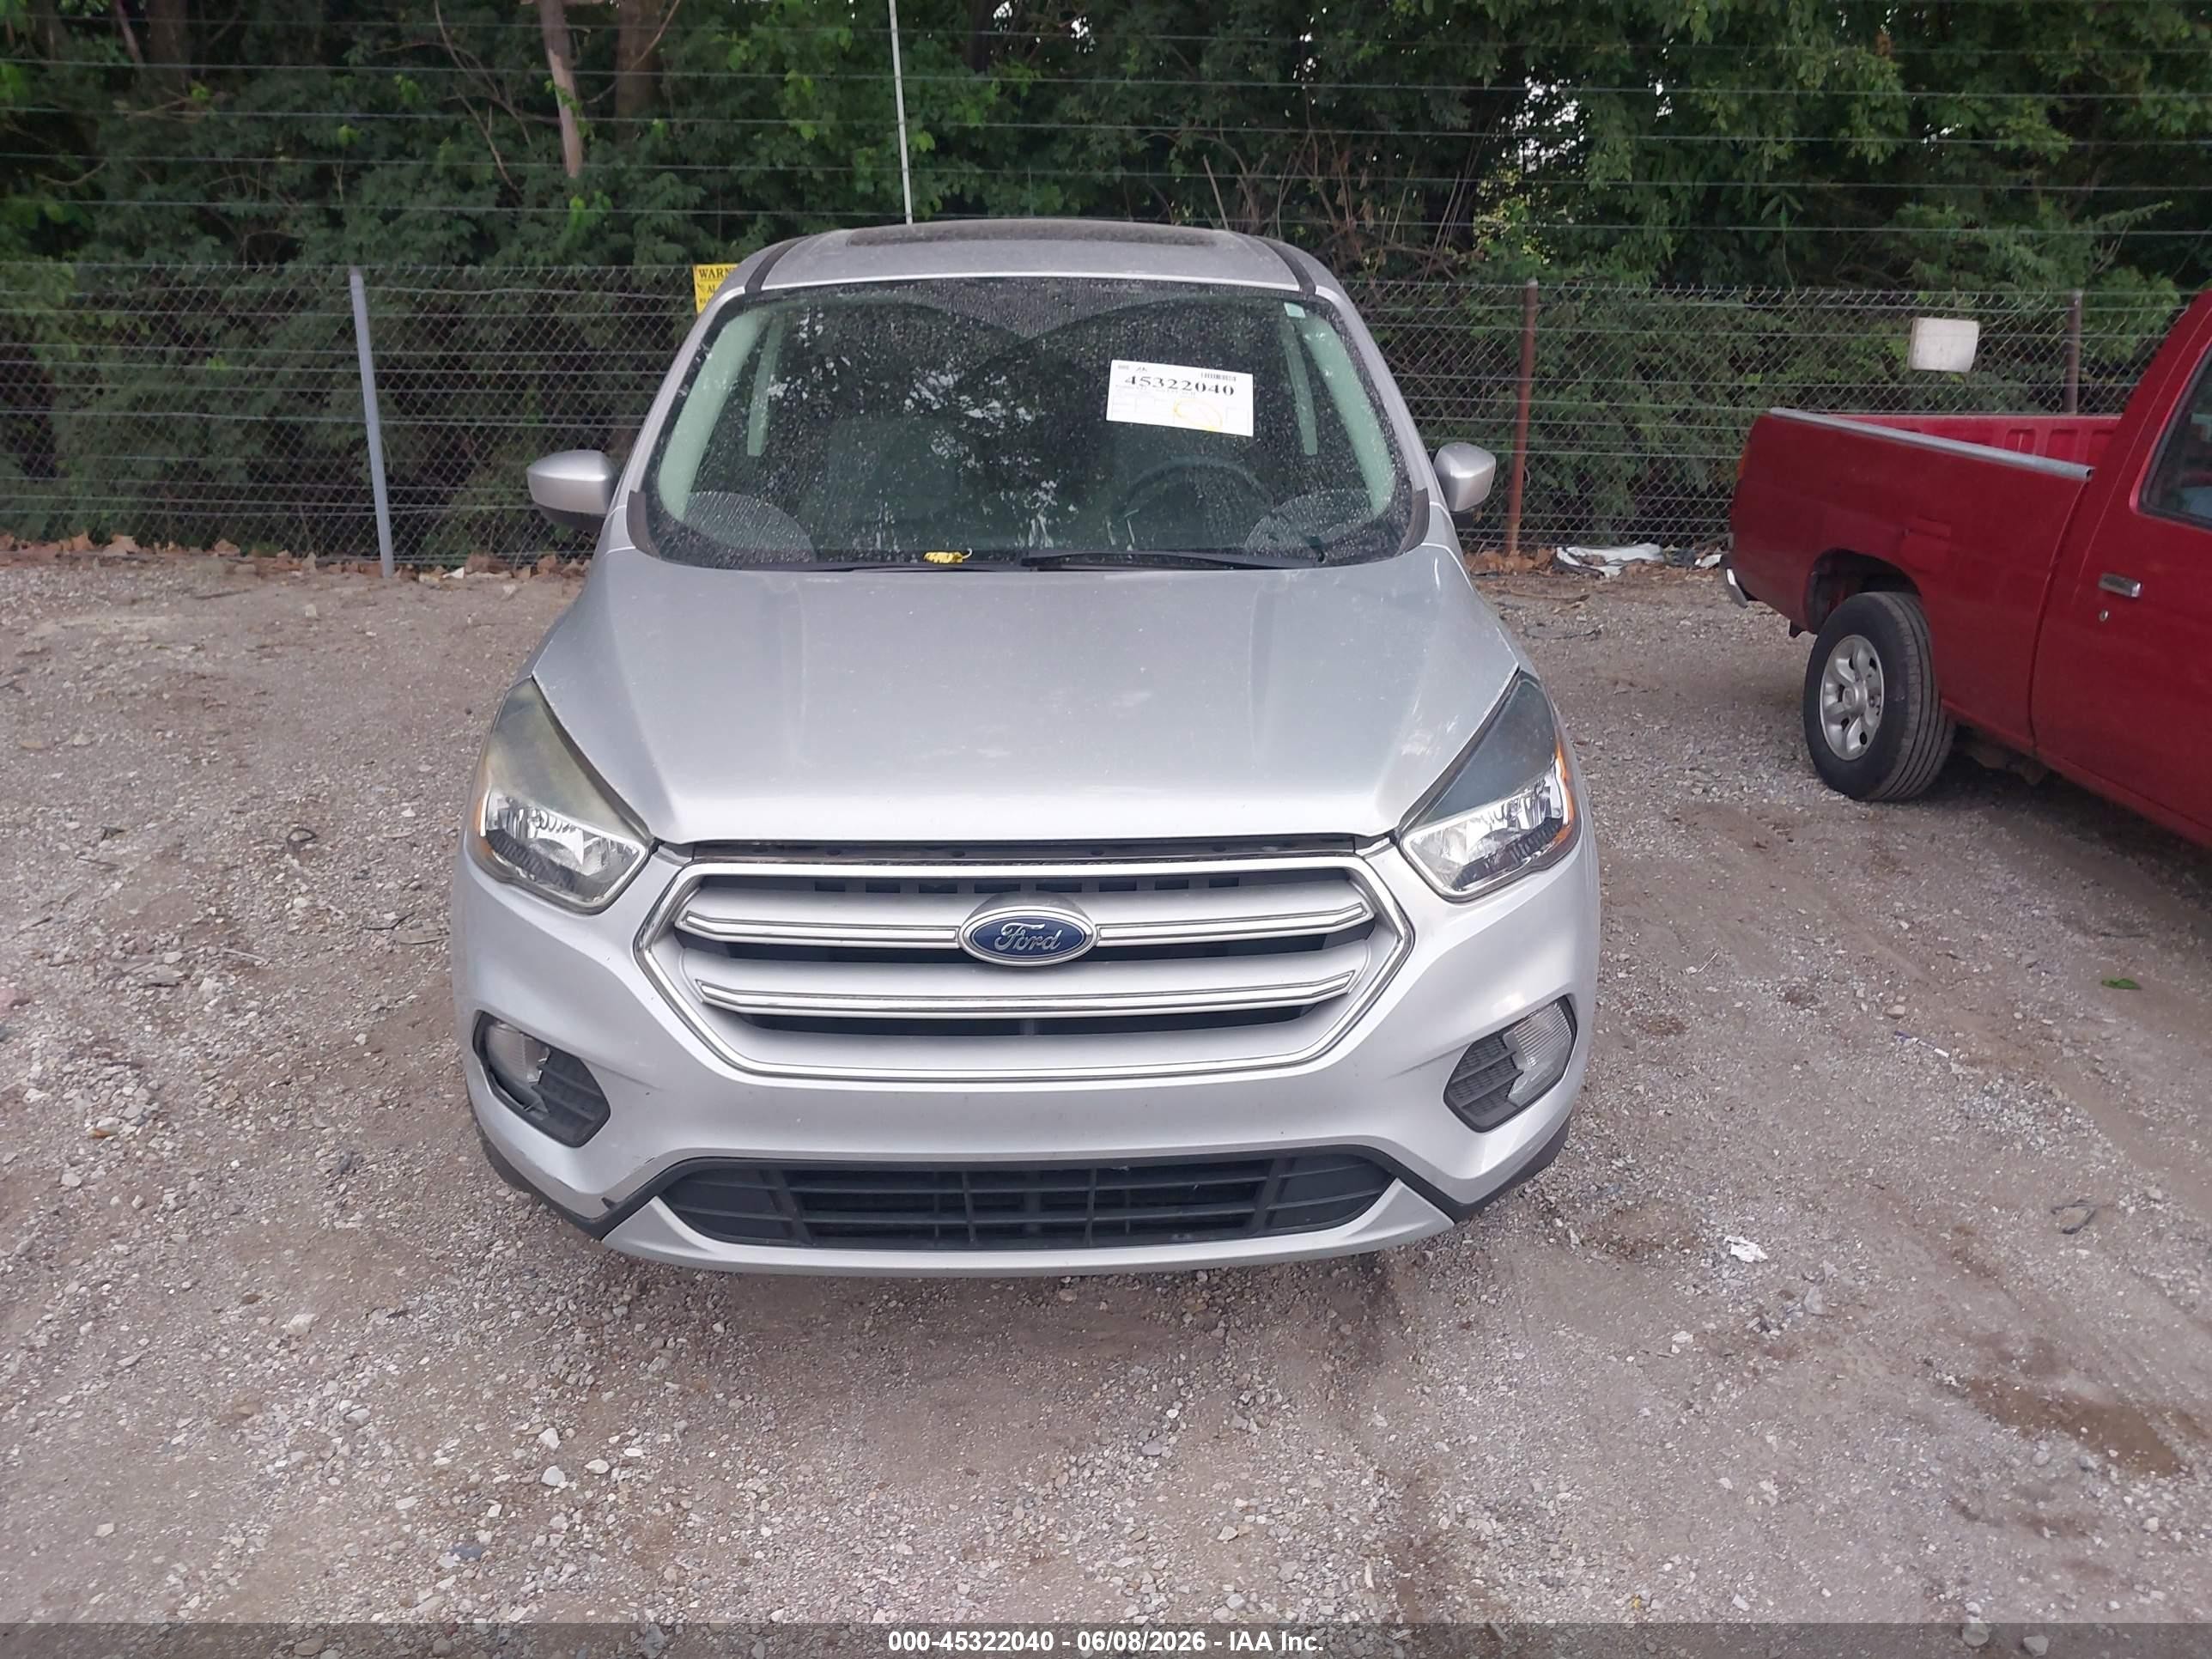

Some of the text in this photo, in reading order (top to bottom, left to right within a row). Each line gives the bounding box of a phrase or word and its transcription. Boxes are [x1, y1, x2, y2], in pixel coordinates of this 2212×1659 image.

[699, 267, 736, 279] WARN
[1124, 375, 1235, 396] 45322040
[994, 922, 1063, 951] Ford
